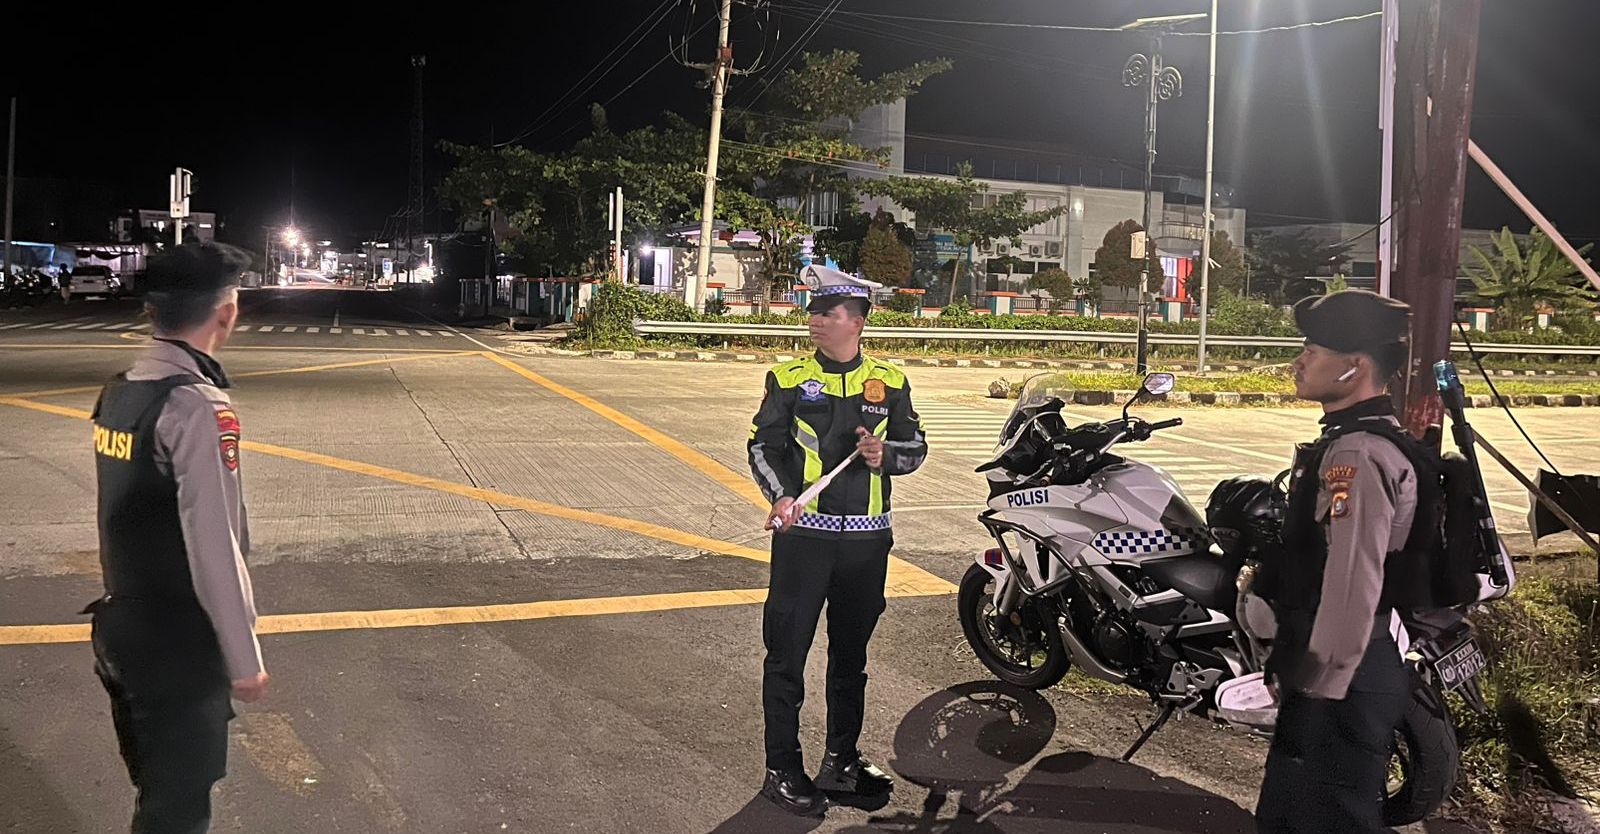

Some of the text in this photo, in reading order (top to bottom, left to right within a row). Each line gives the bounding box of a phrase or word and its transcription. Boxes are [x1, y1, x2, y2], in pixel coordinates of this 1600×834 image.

[861, 404, 888, 415] POLRI
[94, 426, 132, 460] POLISI
[1007, 489, 1049, 508] POLISI
[1458, 653, 1483, 679] 12012
